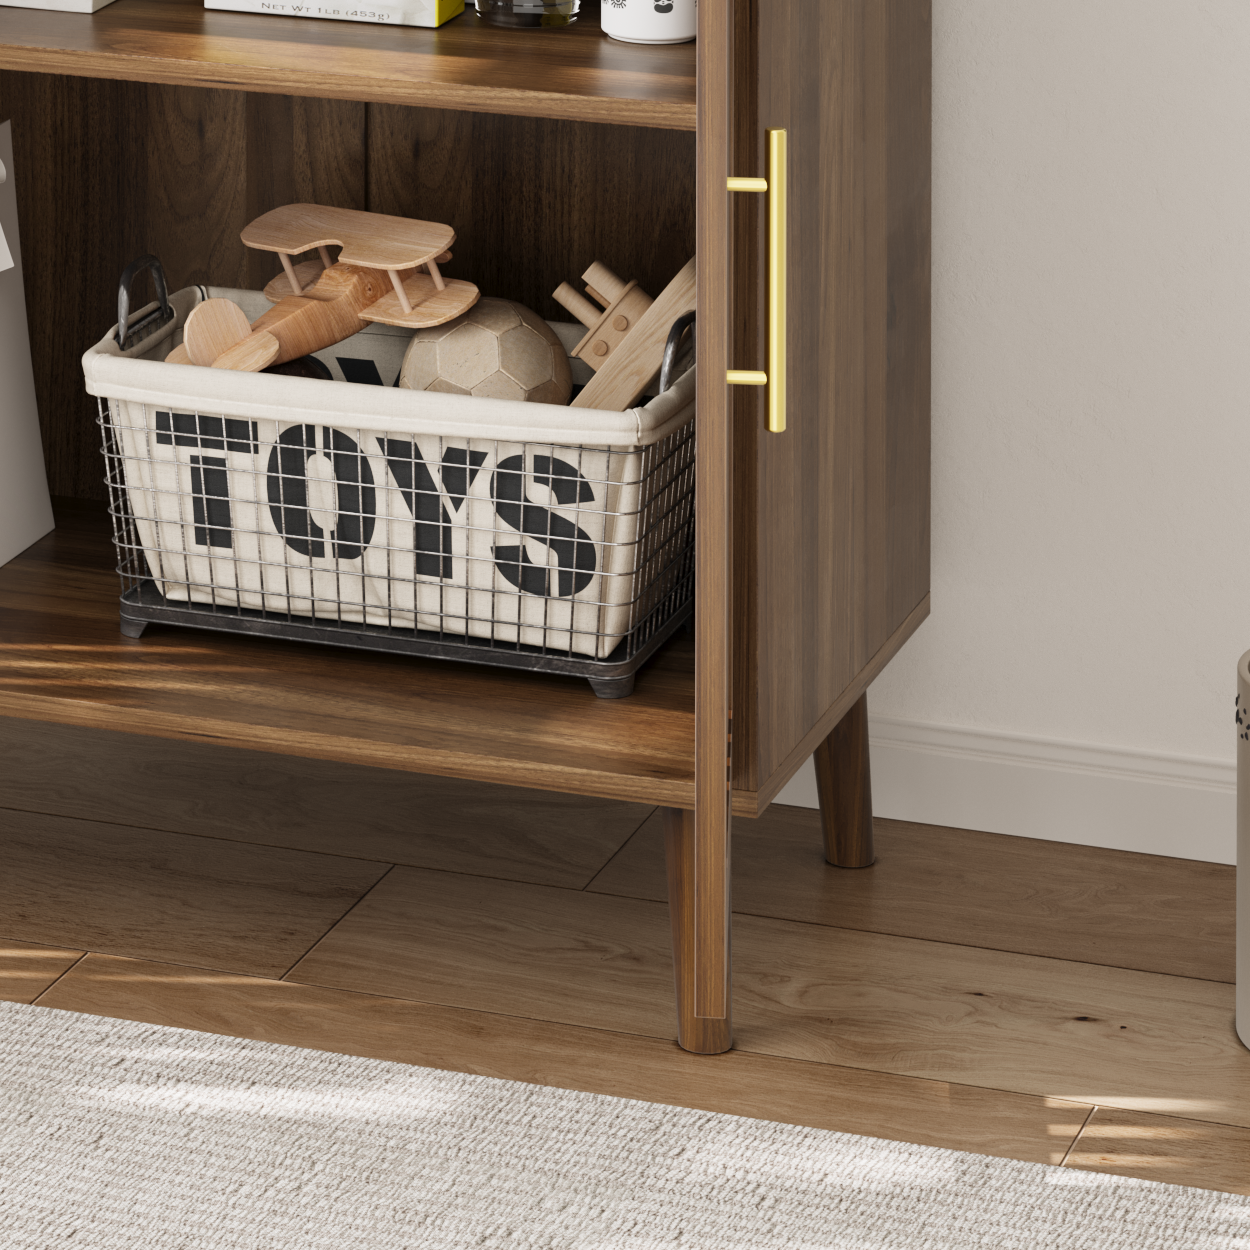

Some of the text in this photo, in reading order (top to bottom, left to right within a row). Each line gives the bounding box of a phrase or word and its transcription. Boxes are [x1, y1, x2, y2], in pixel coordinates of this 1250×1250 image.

[261, 2, 286, 10] NET
[292, 5, 311, 13] WT
[155, 411, 597, 598] TOYS
